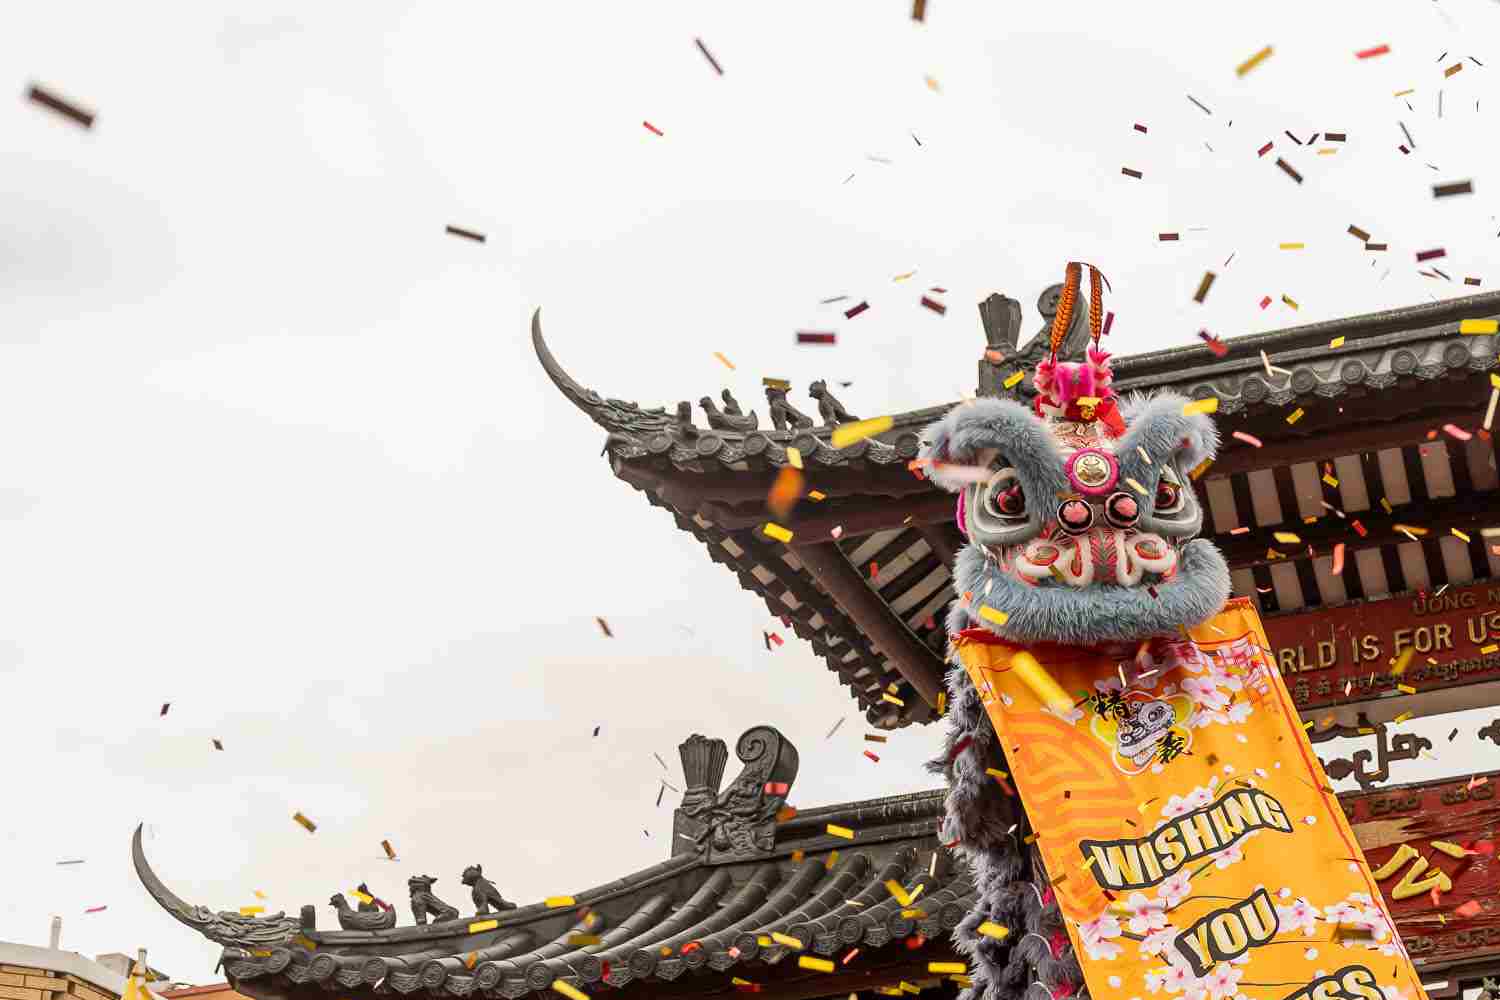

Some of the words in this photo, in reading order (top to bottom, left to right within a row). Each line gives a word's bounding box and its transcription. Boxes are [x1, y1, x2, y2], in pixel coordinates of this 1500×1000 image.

[1352, 634, 1380, 664] IS
[1394, 621, 1453, 659] FOR
[1081, 788, 1293, 890] WISHING
[1174, 888, 1281, 978] YOU
